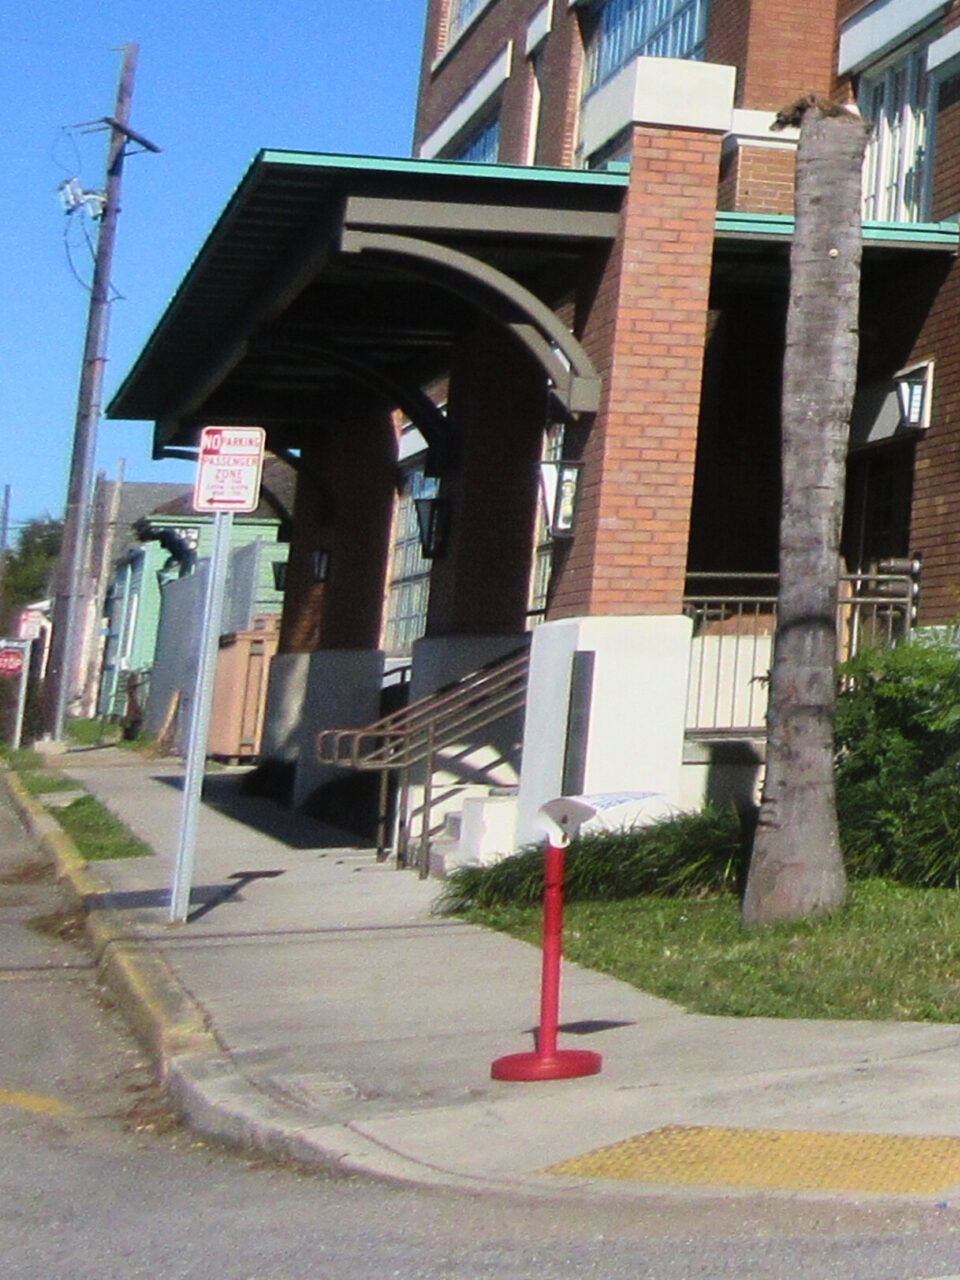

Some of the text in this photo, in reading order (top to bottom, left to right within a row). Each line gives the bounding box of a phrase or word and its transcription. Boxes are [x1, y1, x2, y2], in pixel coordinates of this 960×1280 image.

[203, 434, 260, 450] NO PARKING
[201, 456, 258, 466] PASSENGER
[215, 469, 242, 479] ZONE
